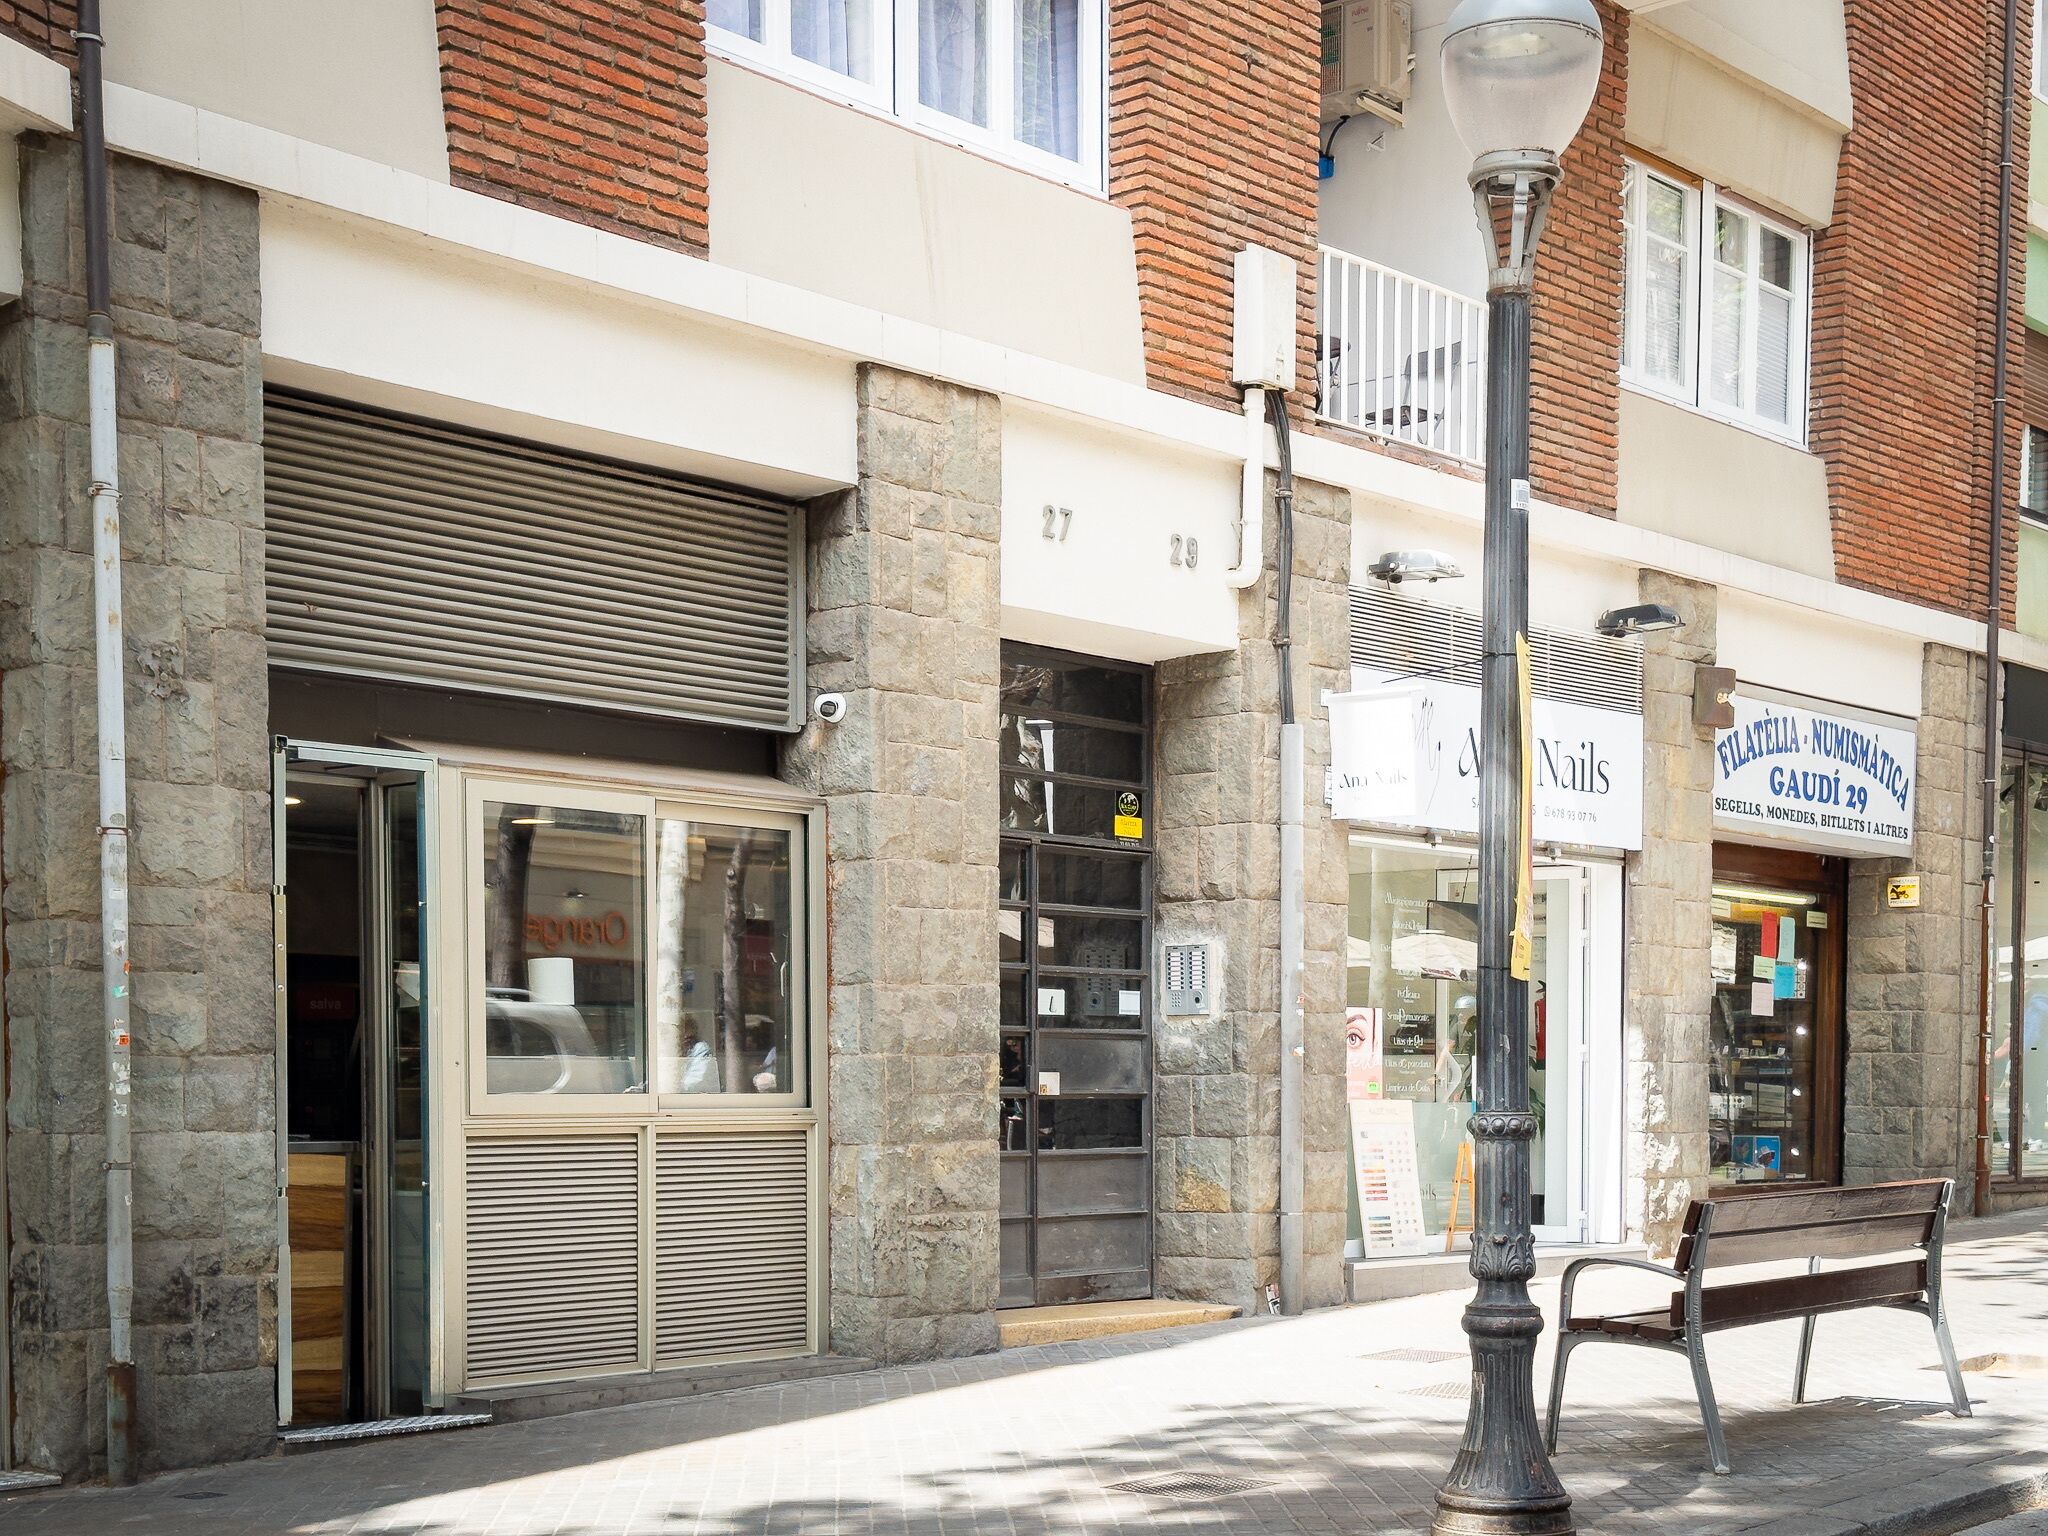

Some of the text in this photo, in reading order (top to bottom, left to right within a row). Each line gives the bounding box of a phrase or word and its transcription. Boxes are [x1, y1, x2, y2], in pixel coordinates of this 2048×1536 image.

[1043, 505, 1072, 541] 27
[1170, 533, 1198, 568] 29
[1537, 737, 1610, 795] Nails
[1717, 708, 1910, 812] FILATÈLIA NUMISMÀTICA
[1769, 766, 1868, 815] GAUDÍ 29
[1551, 808, 1565, 819] 678
[1714, 797, 1764, 820] SEGELLS,
[1766, 805, 1818, 828] MONEDES,
[1873, 823, 1909, 840] ALTRES
